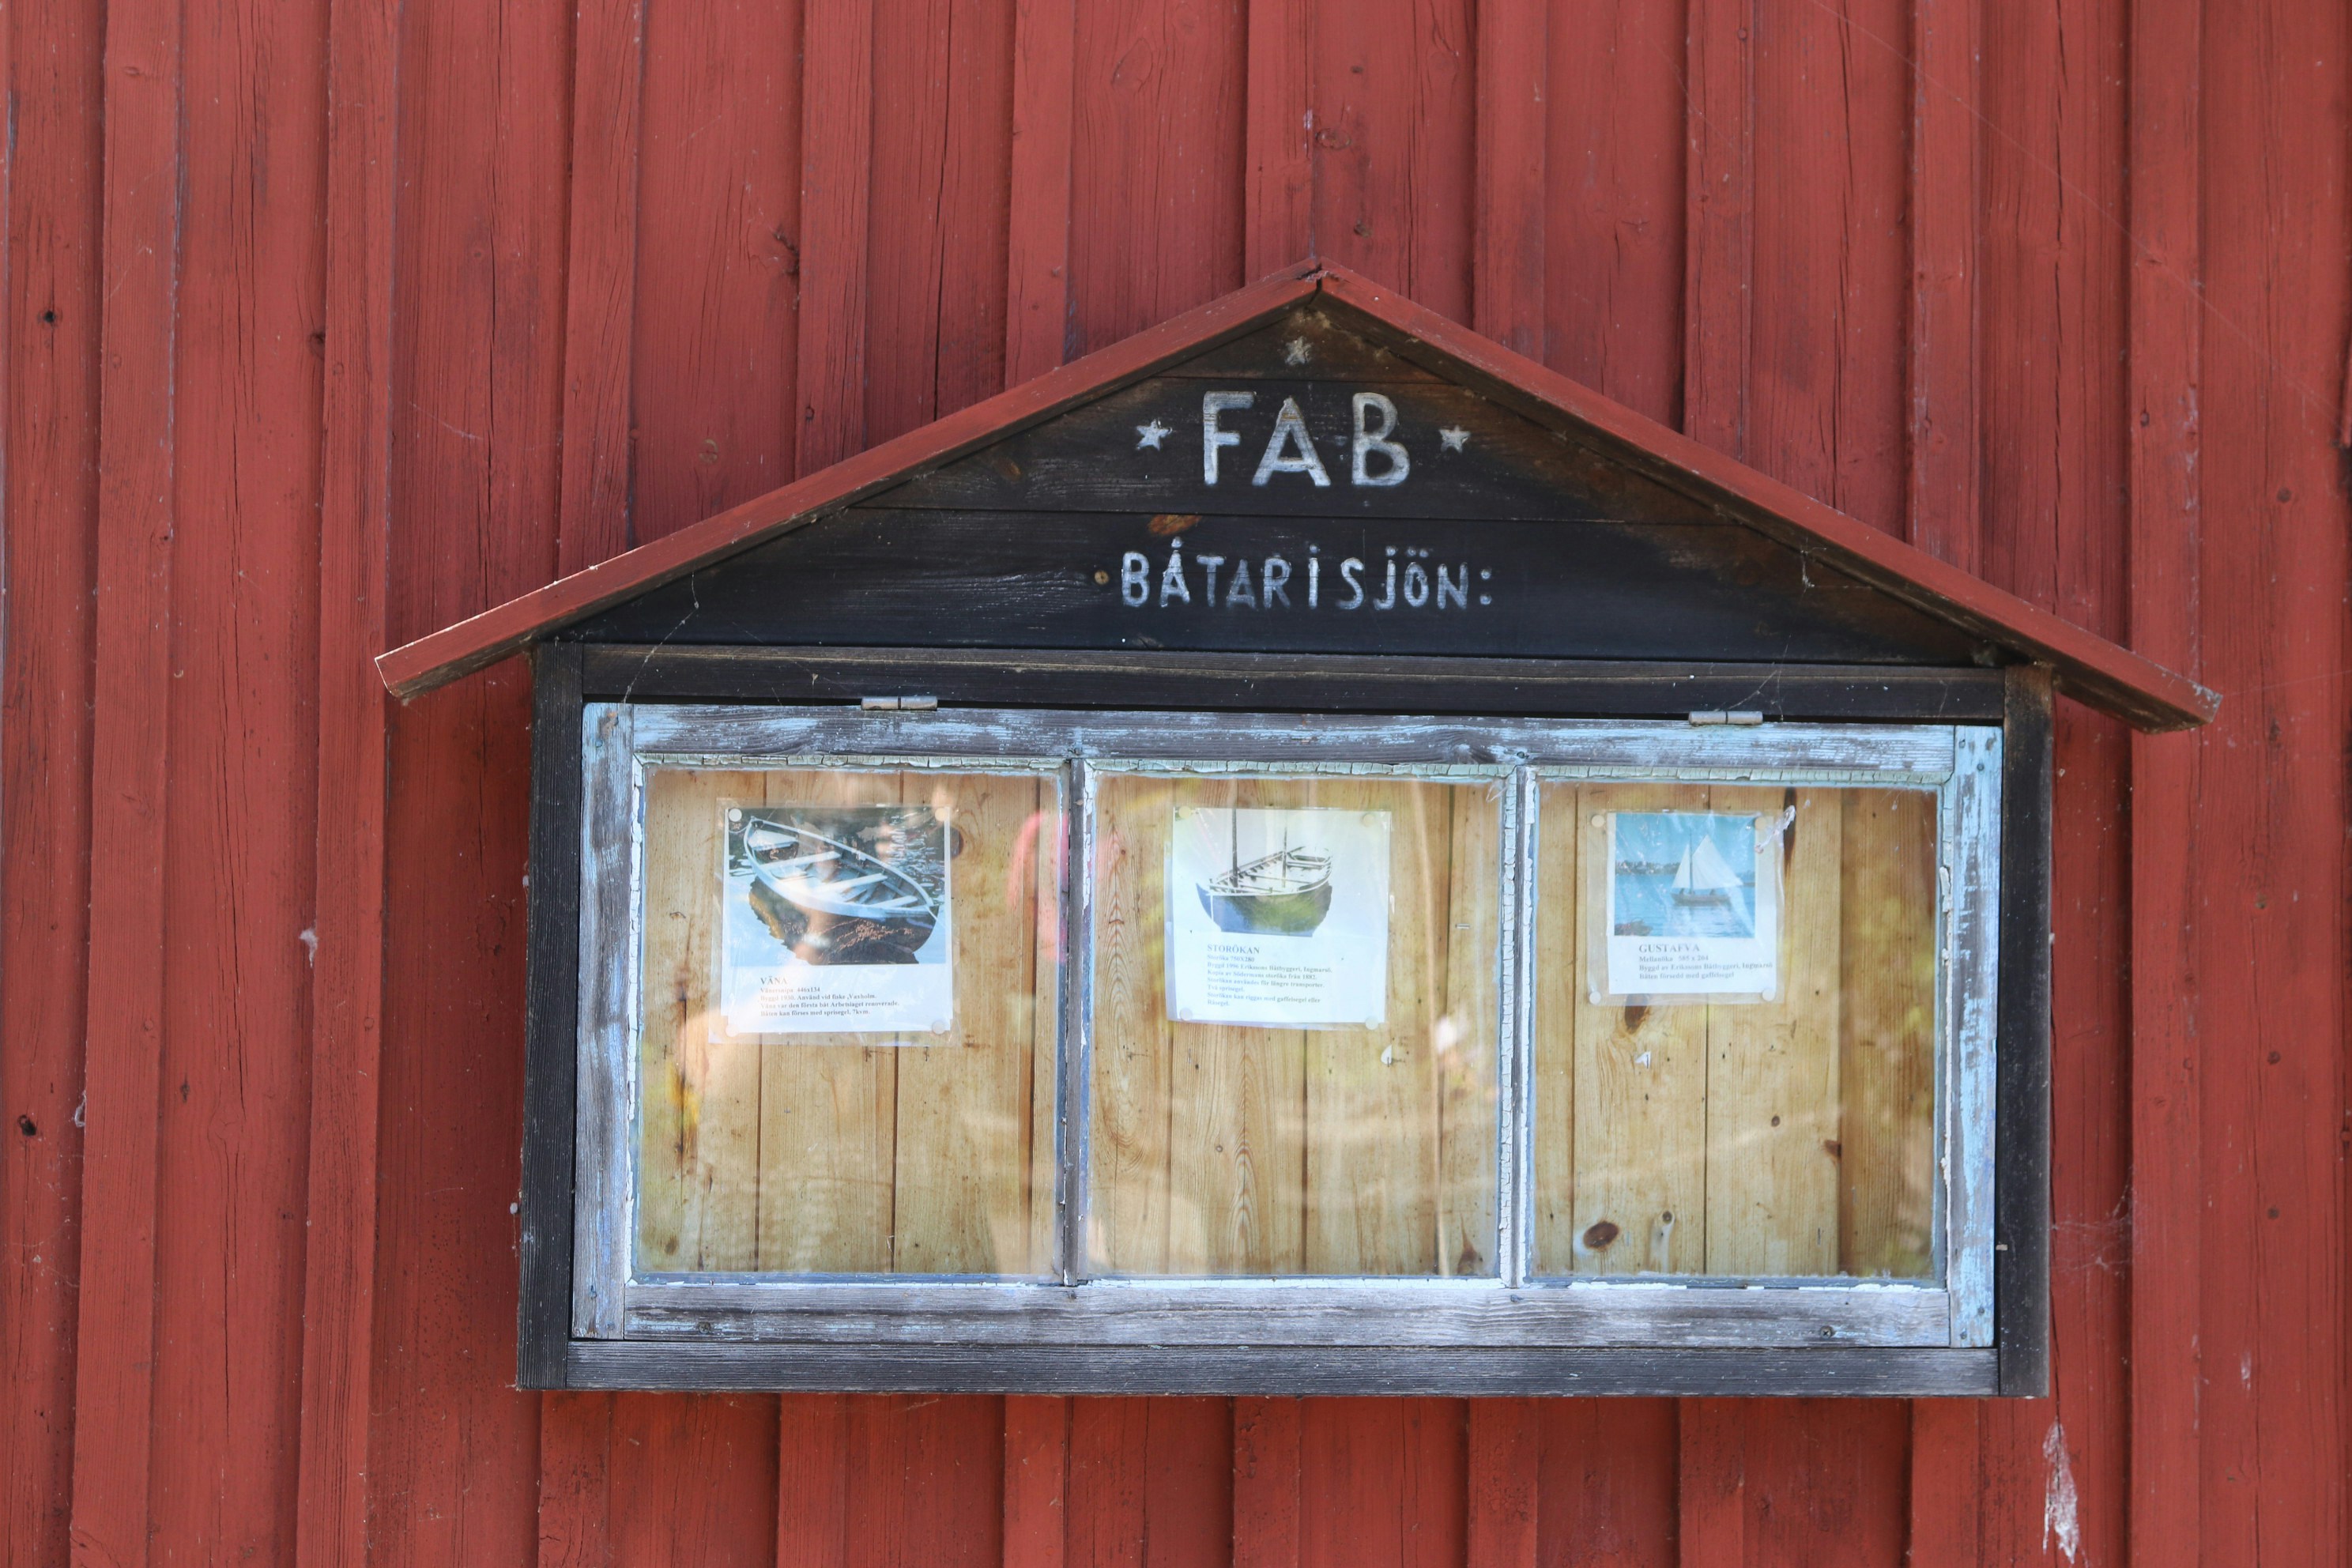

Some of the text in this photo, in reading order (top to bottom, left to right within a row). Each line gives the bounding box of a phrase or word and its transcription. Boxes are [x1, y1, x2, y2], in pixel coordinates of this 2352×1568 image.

[1202, 390, 1411, 487] FAB
[1208, 944, 1260, 954] STORÖKAN
[1638, 944, 1700, 953] GUSTAFVA
[760, 975, 787, 985] VÄNA
